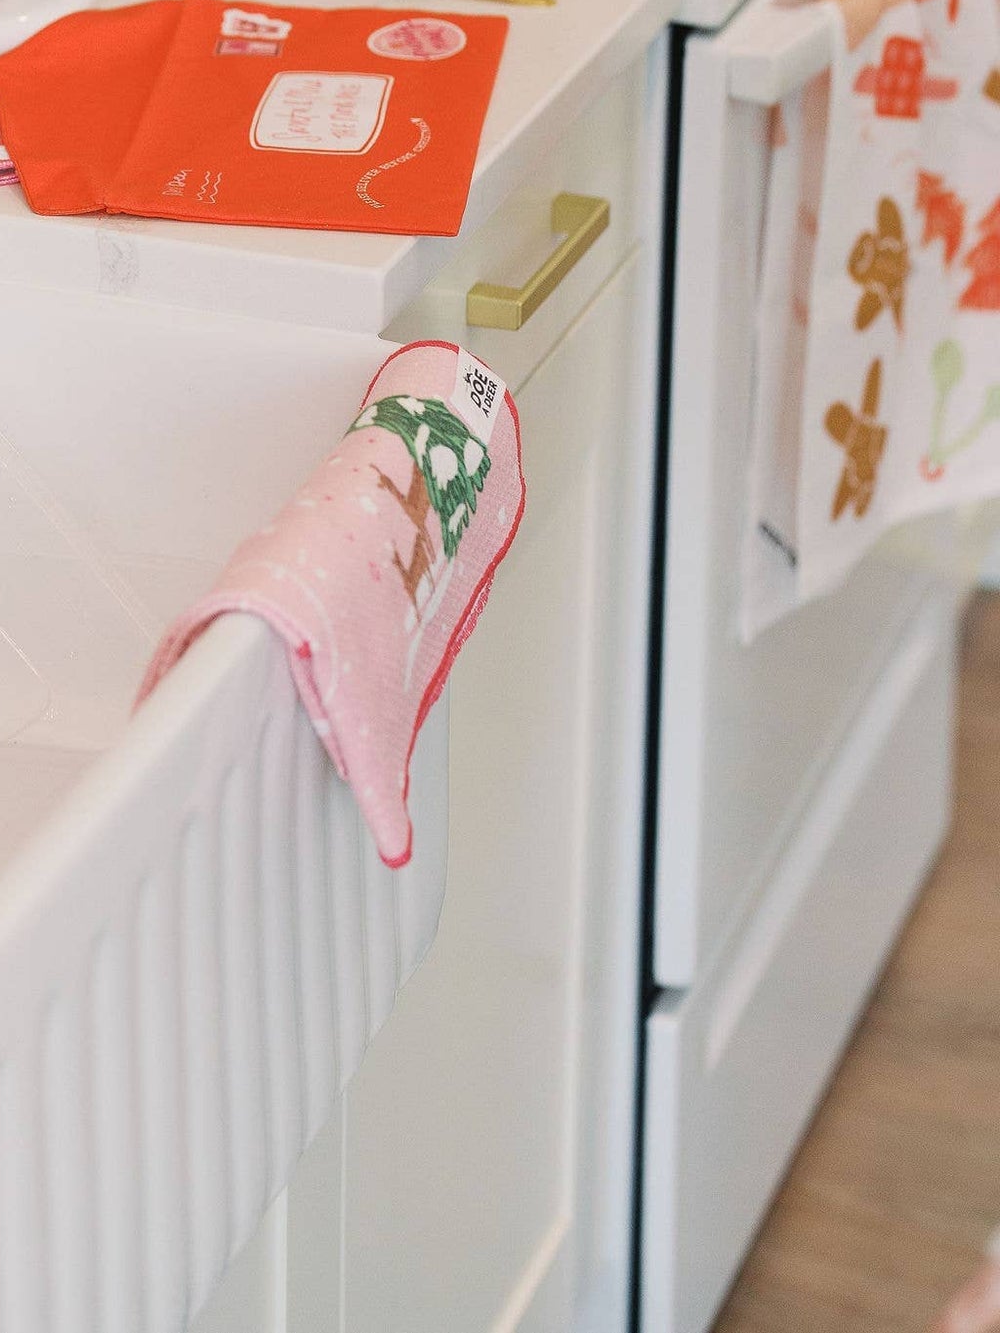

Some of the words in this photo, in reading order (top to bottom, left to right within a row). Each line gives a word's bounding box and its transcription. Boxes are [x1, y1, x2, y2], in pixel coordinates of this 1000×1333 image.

[471, 368, 488, 408] DOE
[484, 380, 498, 408] DEER
[482, 407, 490, 419] A
